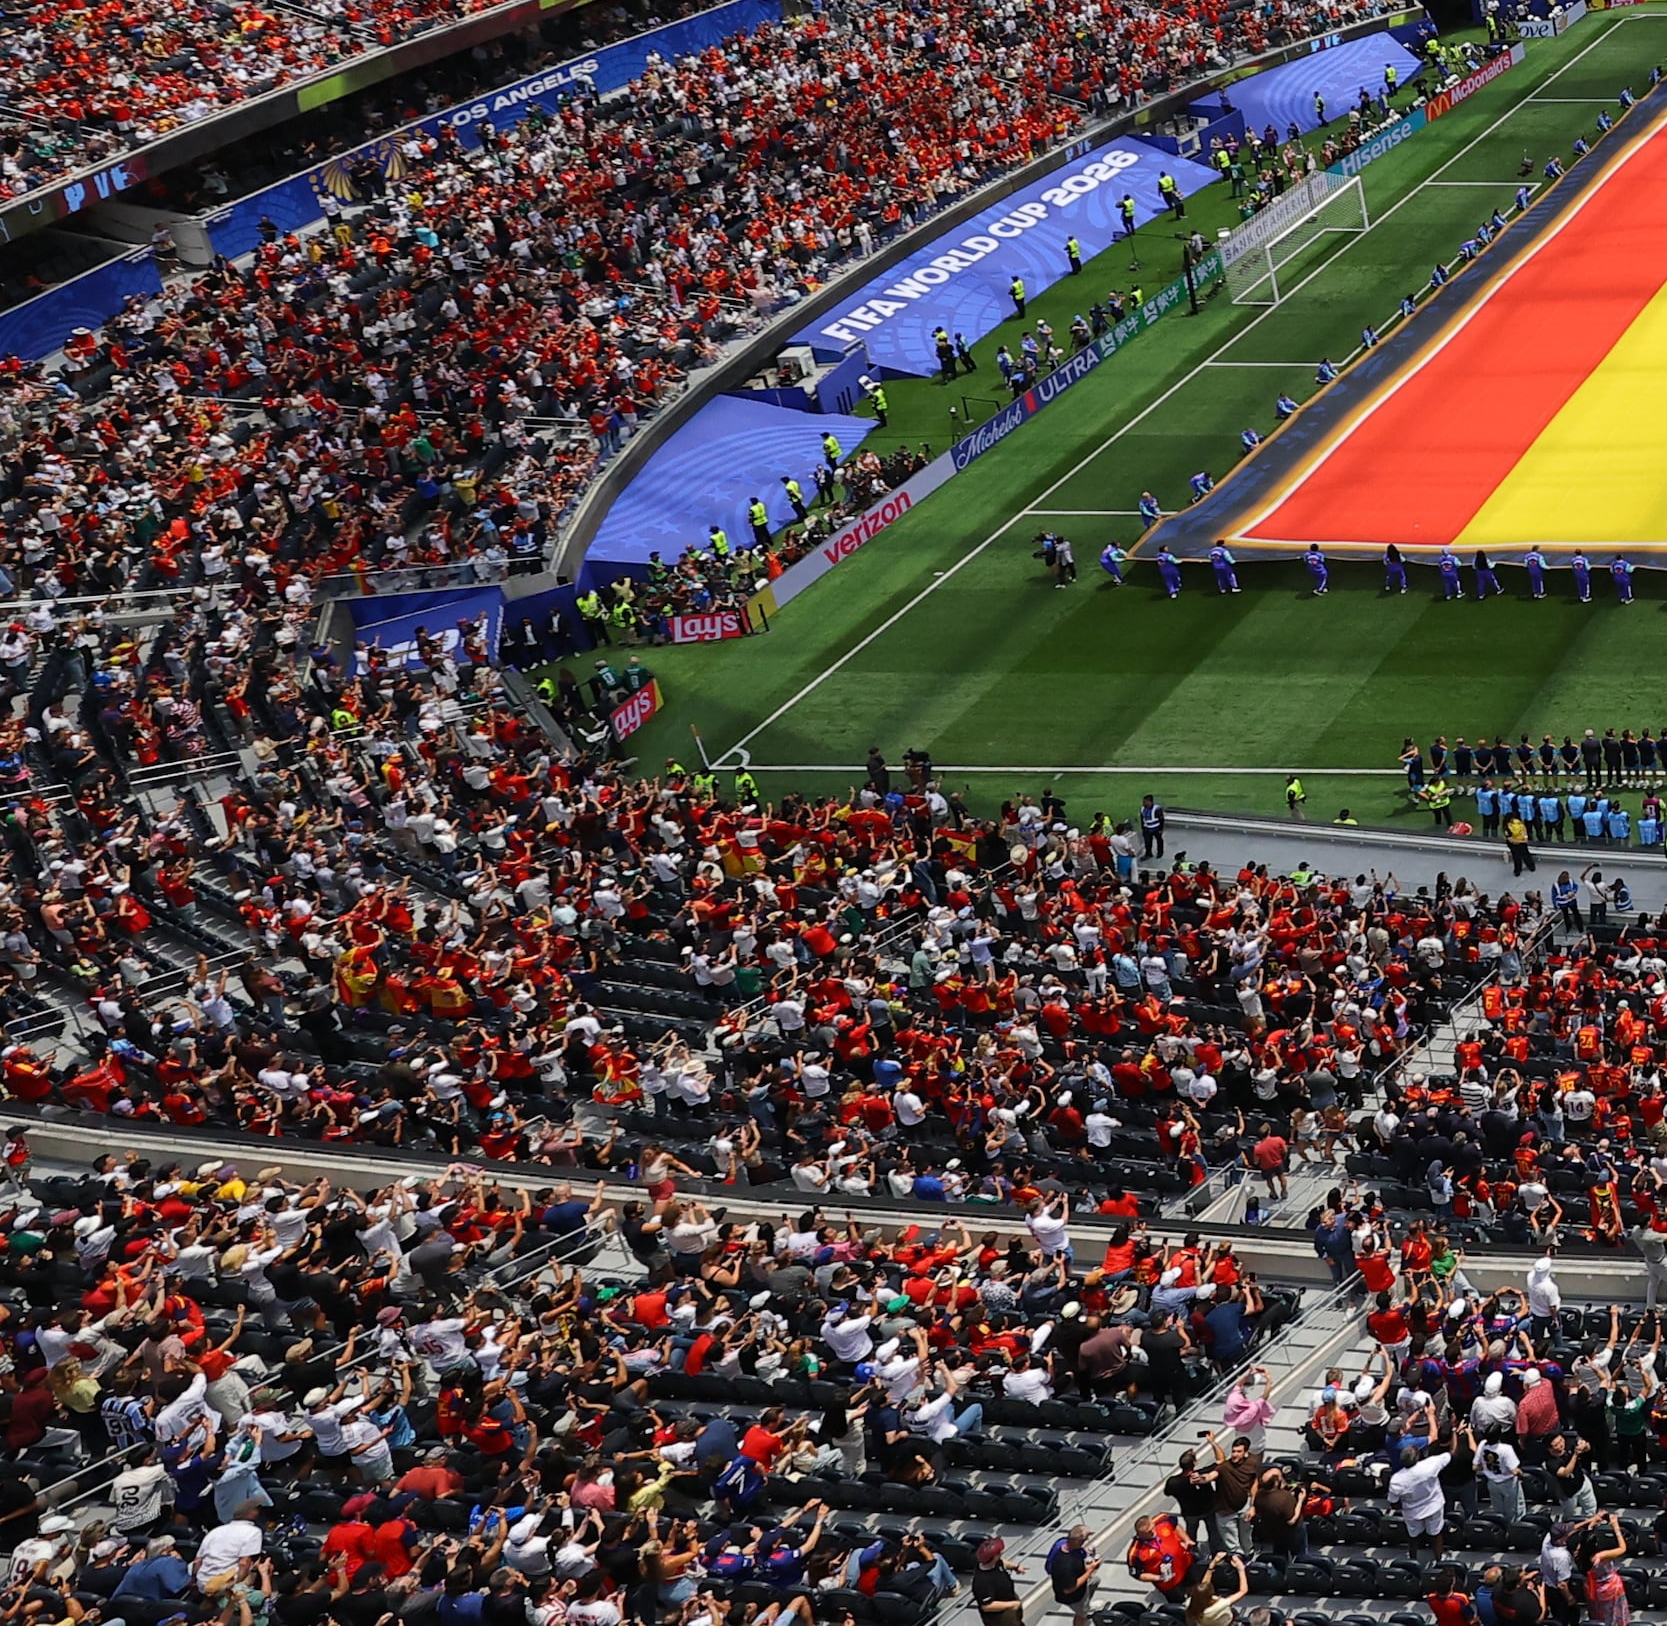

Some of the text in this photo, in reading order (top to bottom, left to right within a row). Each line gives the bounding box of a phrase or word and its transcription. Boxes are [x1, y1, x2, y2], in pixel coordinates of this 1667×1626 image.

[1519, 23, 1549, 39] ove
[493, 58, 599, 111] ANGELES
[1450, 51, 1512, 105] McDonald's
[1341, 120, 1413, 177] Hisense
[820, 148, 1140, 342] FIFA WORLD CUP 2026
[956, 347, 1101, 471] Michelob ULTRA
[823, 490, 913, 565] verizon
[674, 612, 739, 644] Lay's
[614, 689, 652, 742] ay's
[1579, 1035, 1594, 1049] 24
